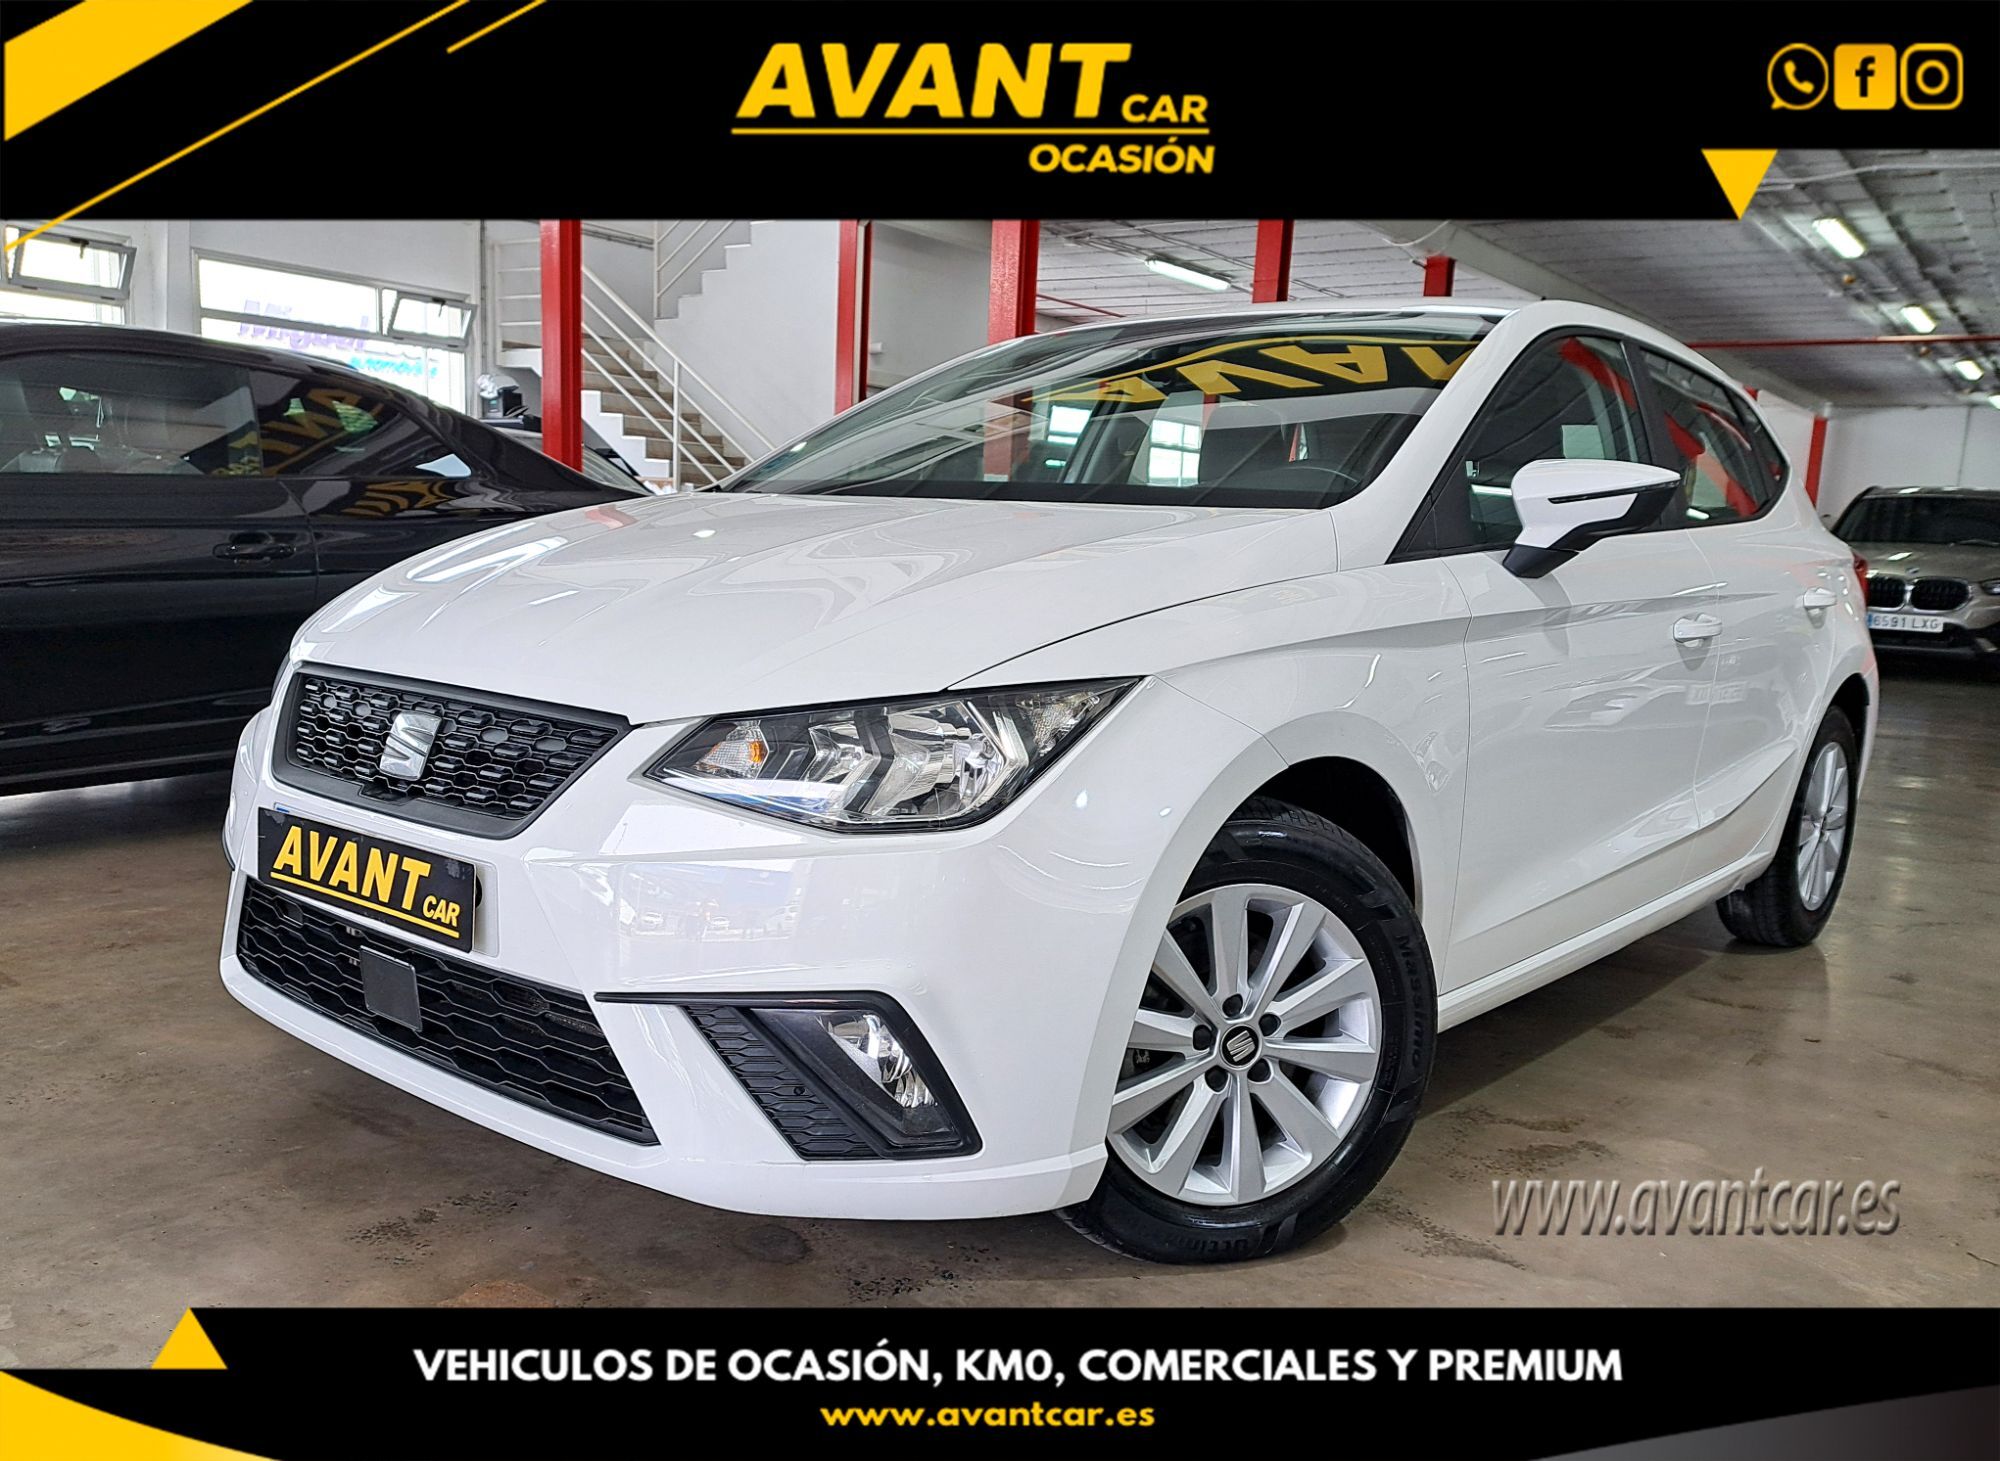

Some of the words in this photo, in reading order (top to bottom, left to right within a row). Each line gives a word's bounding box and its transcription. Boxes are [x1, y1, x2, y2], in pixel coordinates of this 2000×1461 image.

[1873, 614, 1906, 628] 6591
[273, 825, 431, 910] AVANT
[422, 896, 461, 927] CAR
